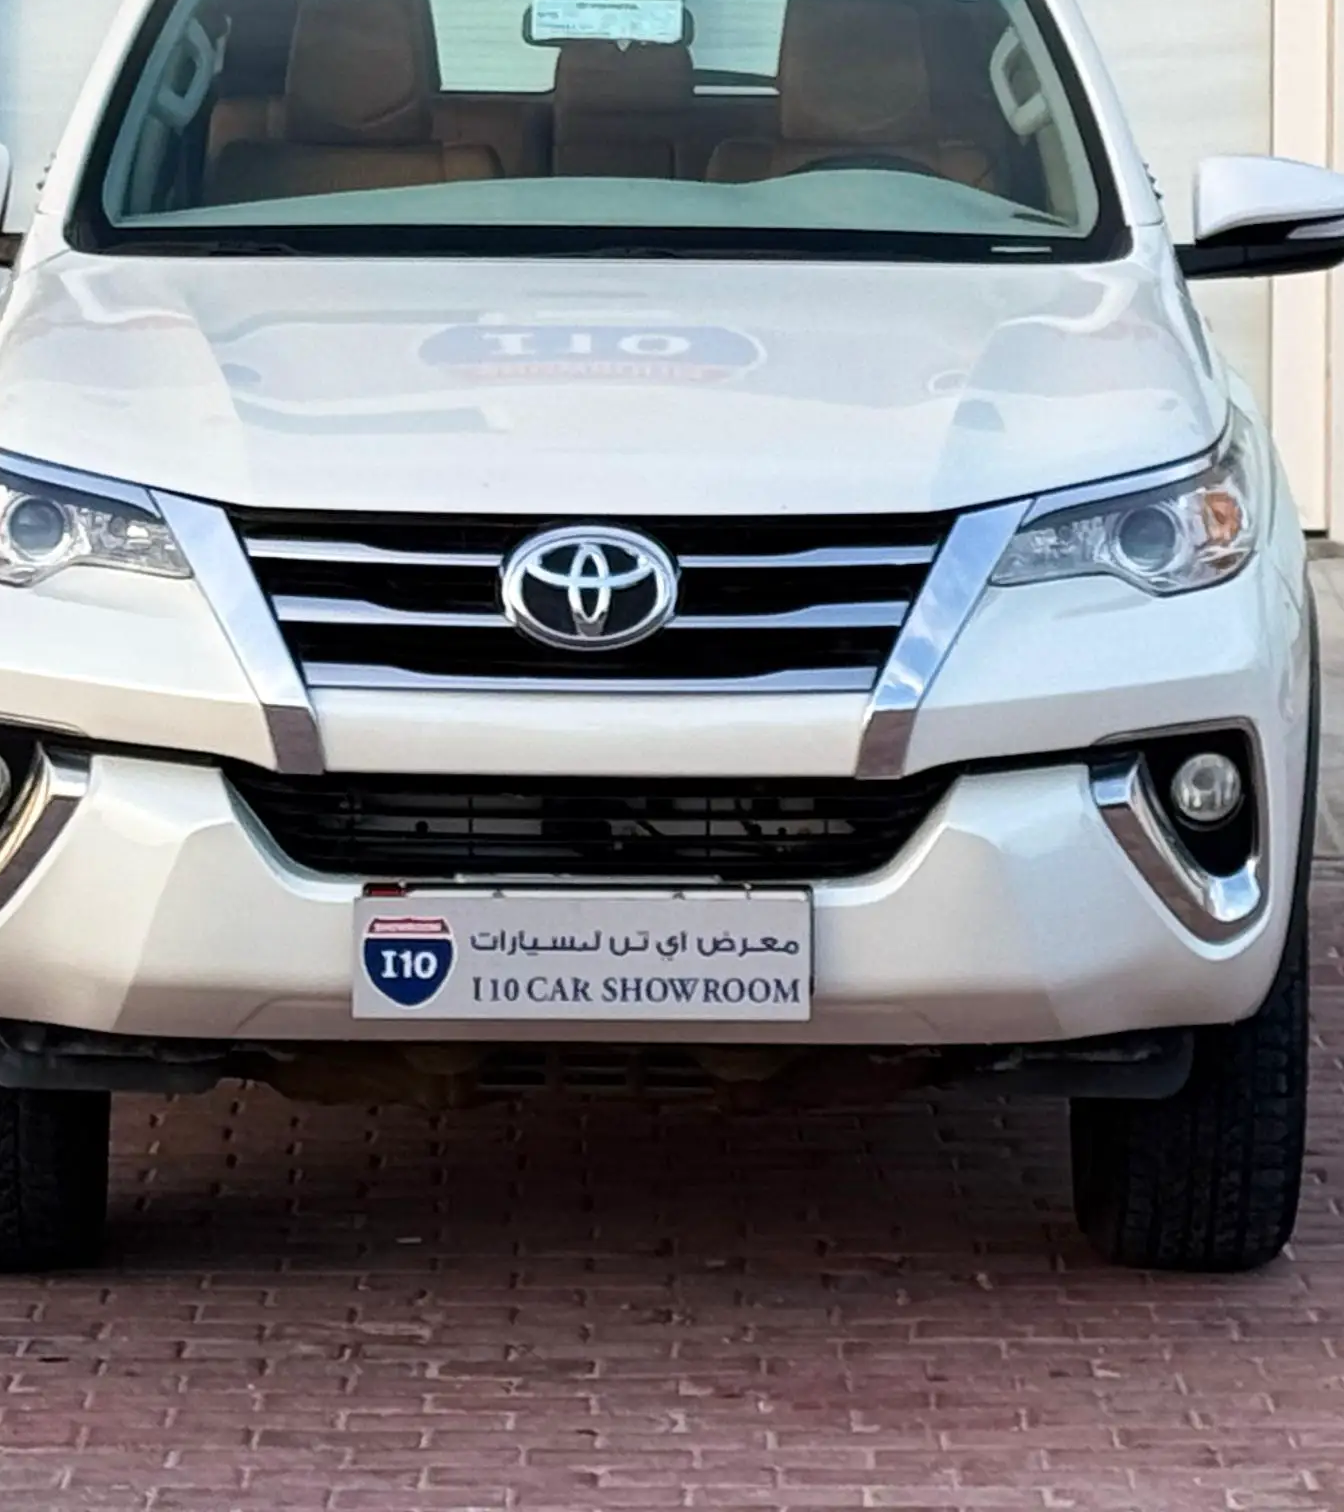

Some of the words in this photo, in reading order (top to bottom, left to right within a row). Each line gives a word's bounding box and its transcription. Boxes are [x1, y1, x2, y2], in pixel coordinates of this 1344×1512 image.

[696, 930, 801, 958] معرض
[380, 949, 439, 980] I10
[526, 975, 594, 1003] CAR
[600, 975, 802, 1004] SHOWROOM
